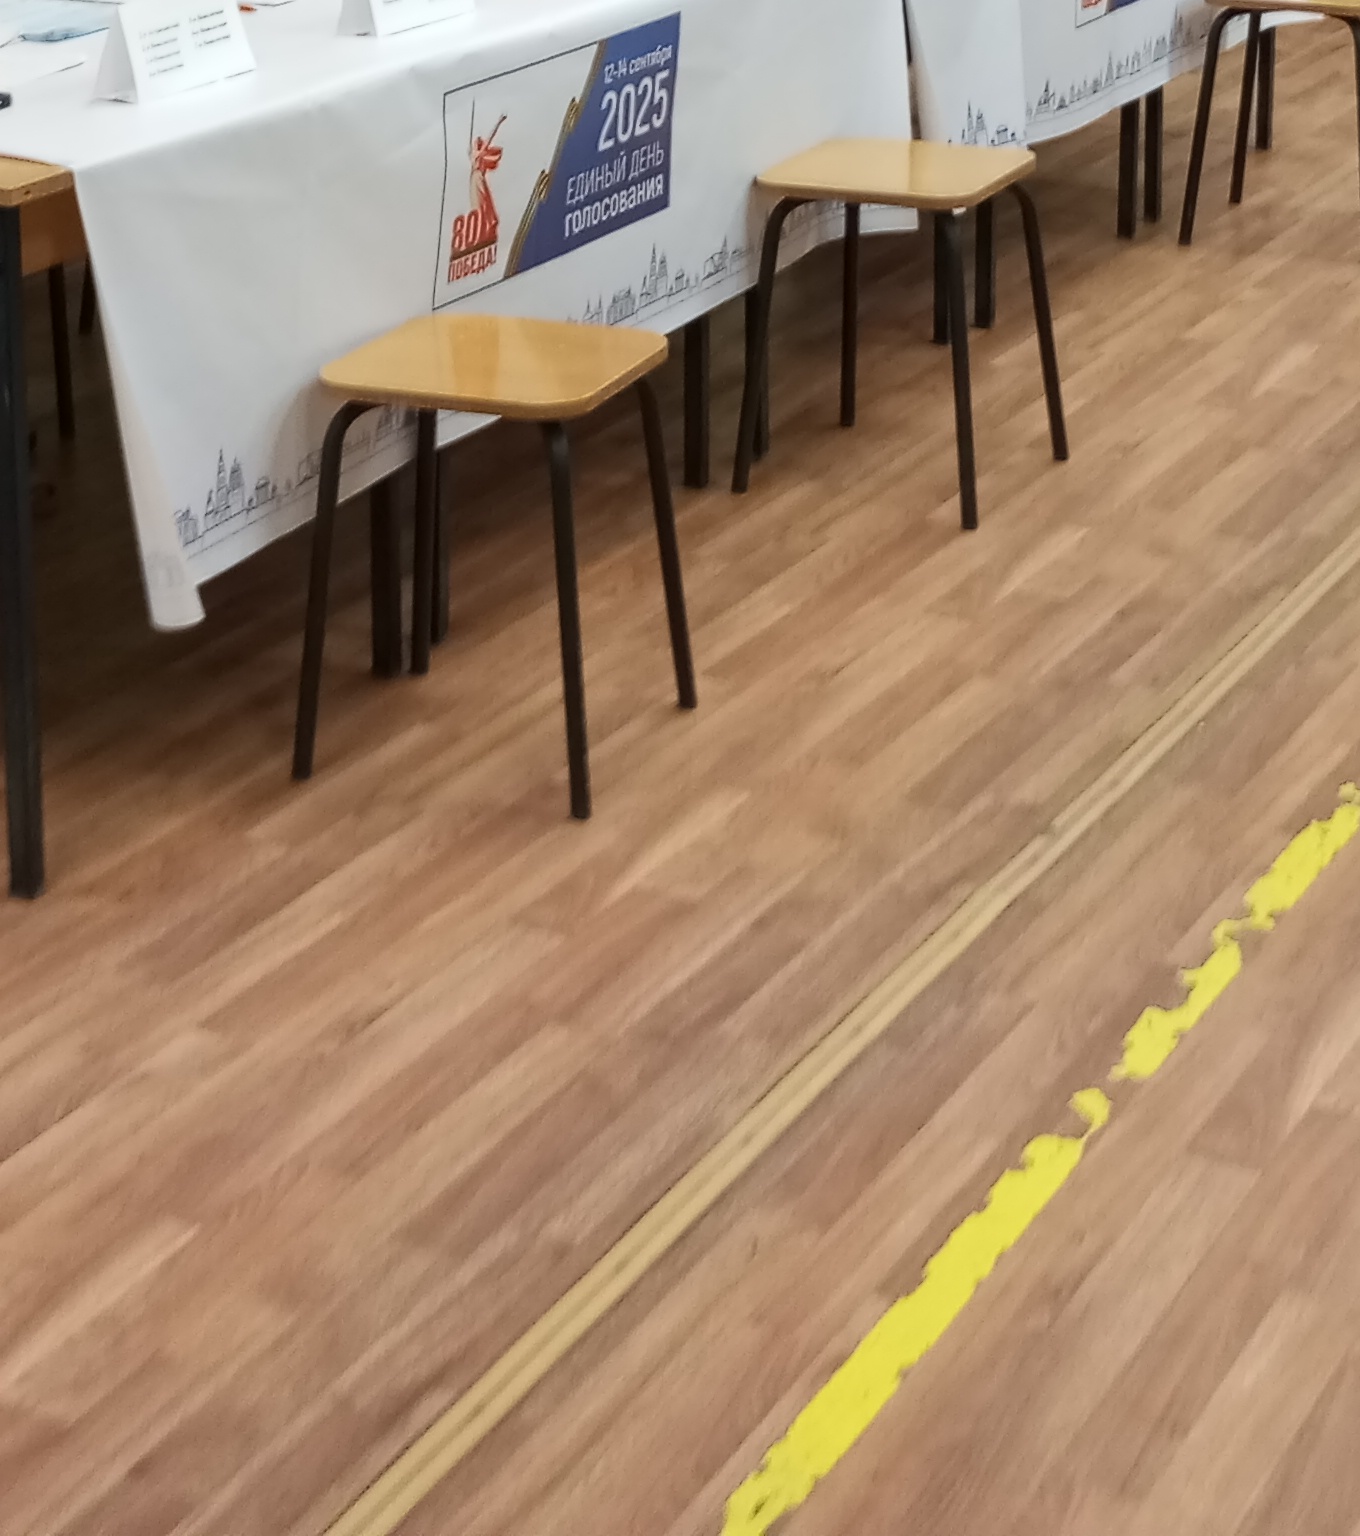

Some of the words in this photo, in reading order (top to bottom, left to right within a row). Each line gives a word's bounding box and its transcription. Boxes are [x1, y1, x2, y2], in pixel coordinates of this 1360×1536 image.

[604, 57, 627, 84] 12-14
[629, 44, 672, 75] сентября
[598, 69, 670, 151] 2025
[566, 150, 627, 205] ЕДИНЫЙ
[628, 140, 664, 182] ДЕНЬ
[452, 208, 479, 251] 80
